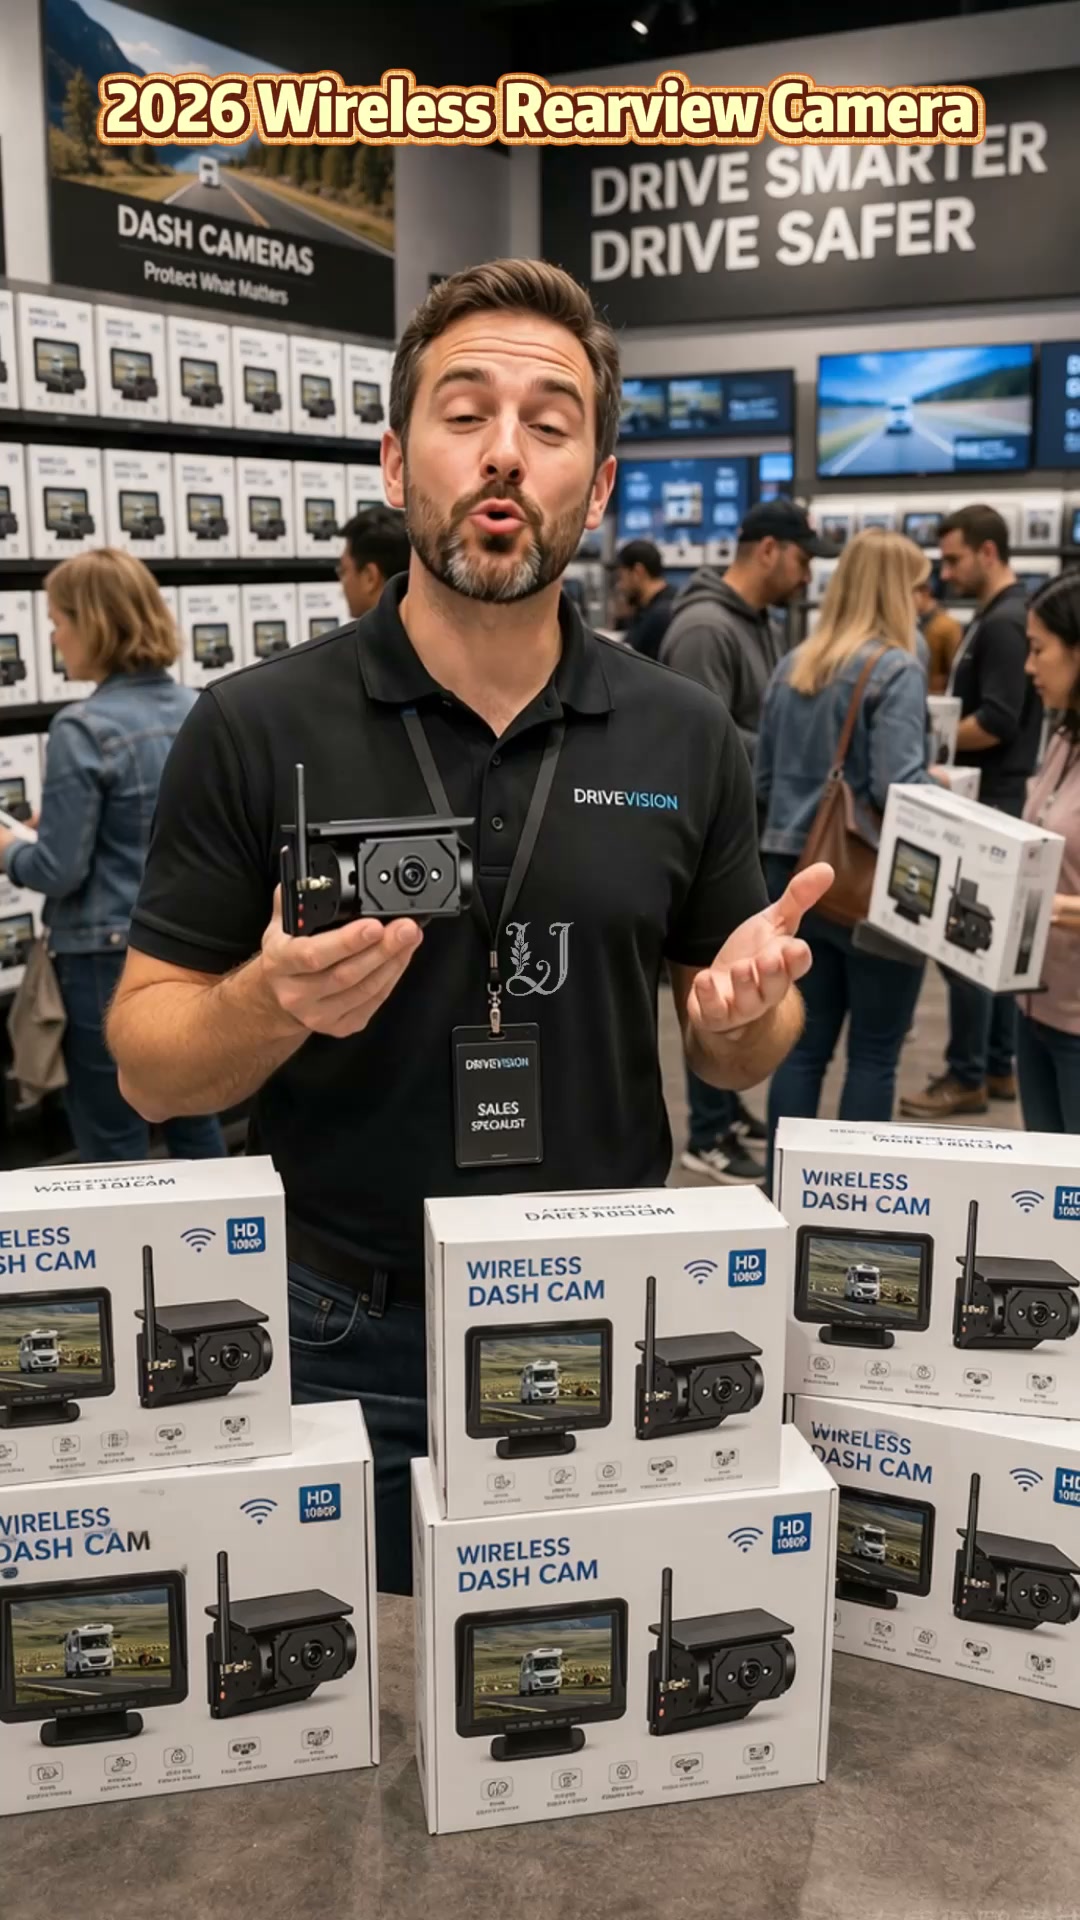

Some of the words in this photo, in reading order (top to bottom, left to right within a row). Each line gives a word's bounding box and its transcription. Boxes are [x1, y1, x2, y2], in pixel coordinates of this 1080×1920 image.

[591, 151, 749, 216] DRIVE
[765, 122, 1047, 198] SMARTER
[117, 205, 193, 250] DASH
[199, 222, 314, 276] CAMERAS
[591, 215, 760, 282] DRIVE
[776, 196, 976, 267] SAFER
[144, 261, 197, 289] Protect
[200, 270, 239, 298] What
[241, 278, 289, 306] Matters
[573, 788, 679, 810] DRIVEVISION
[477, 1101, 520, 1116] SALES
[801, 1168, 909, 1191] WIRELESS
[801, 1190, 868, 1212] DASH
[875, 1195, 931, 1216] CAM
[233, 1222, 259, 1237] HD
[35, 1249, 97, 1272] CAM
[466, 1256, 583, 1280] WIRELESS
[735, 1255, 760, 1271] HD
[468, 1283, 540, 1307] DASH
[547, 1279, 606, 1302] CAM
[811, 1421, 912, 1456] WIRELESS
[811, 1444, 872, 1473] DASH
[878, 1457, 933, 1484] CAM
[307, 1489, 333, 1506] HD
[304, 1505, 337, 1519] 1080P
[779, 1519, 805, 1536] HD
[84, 1530, 151, 1557] CAM
[457, 1537, 571, 1565] WIRELESS
[777, 1536, 808, 1550] 1080P
[458, 1566, 531, 1593] DASH
[538, 1559, 599, 1585] CAM
